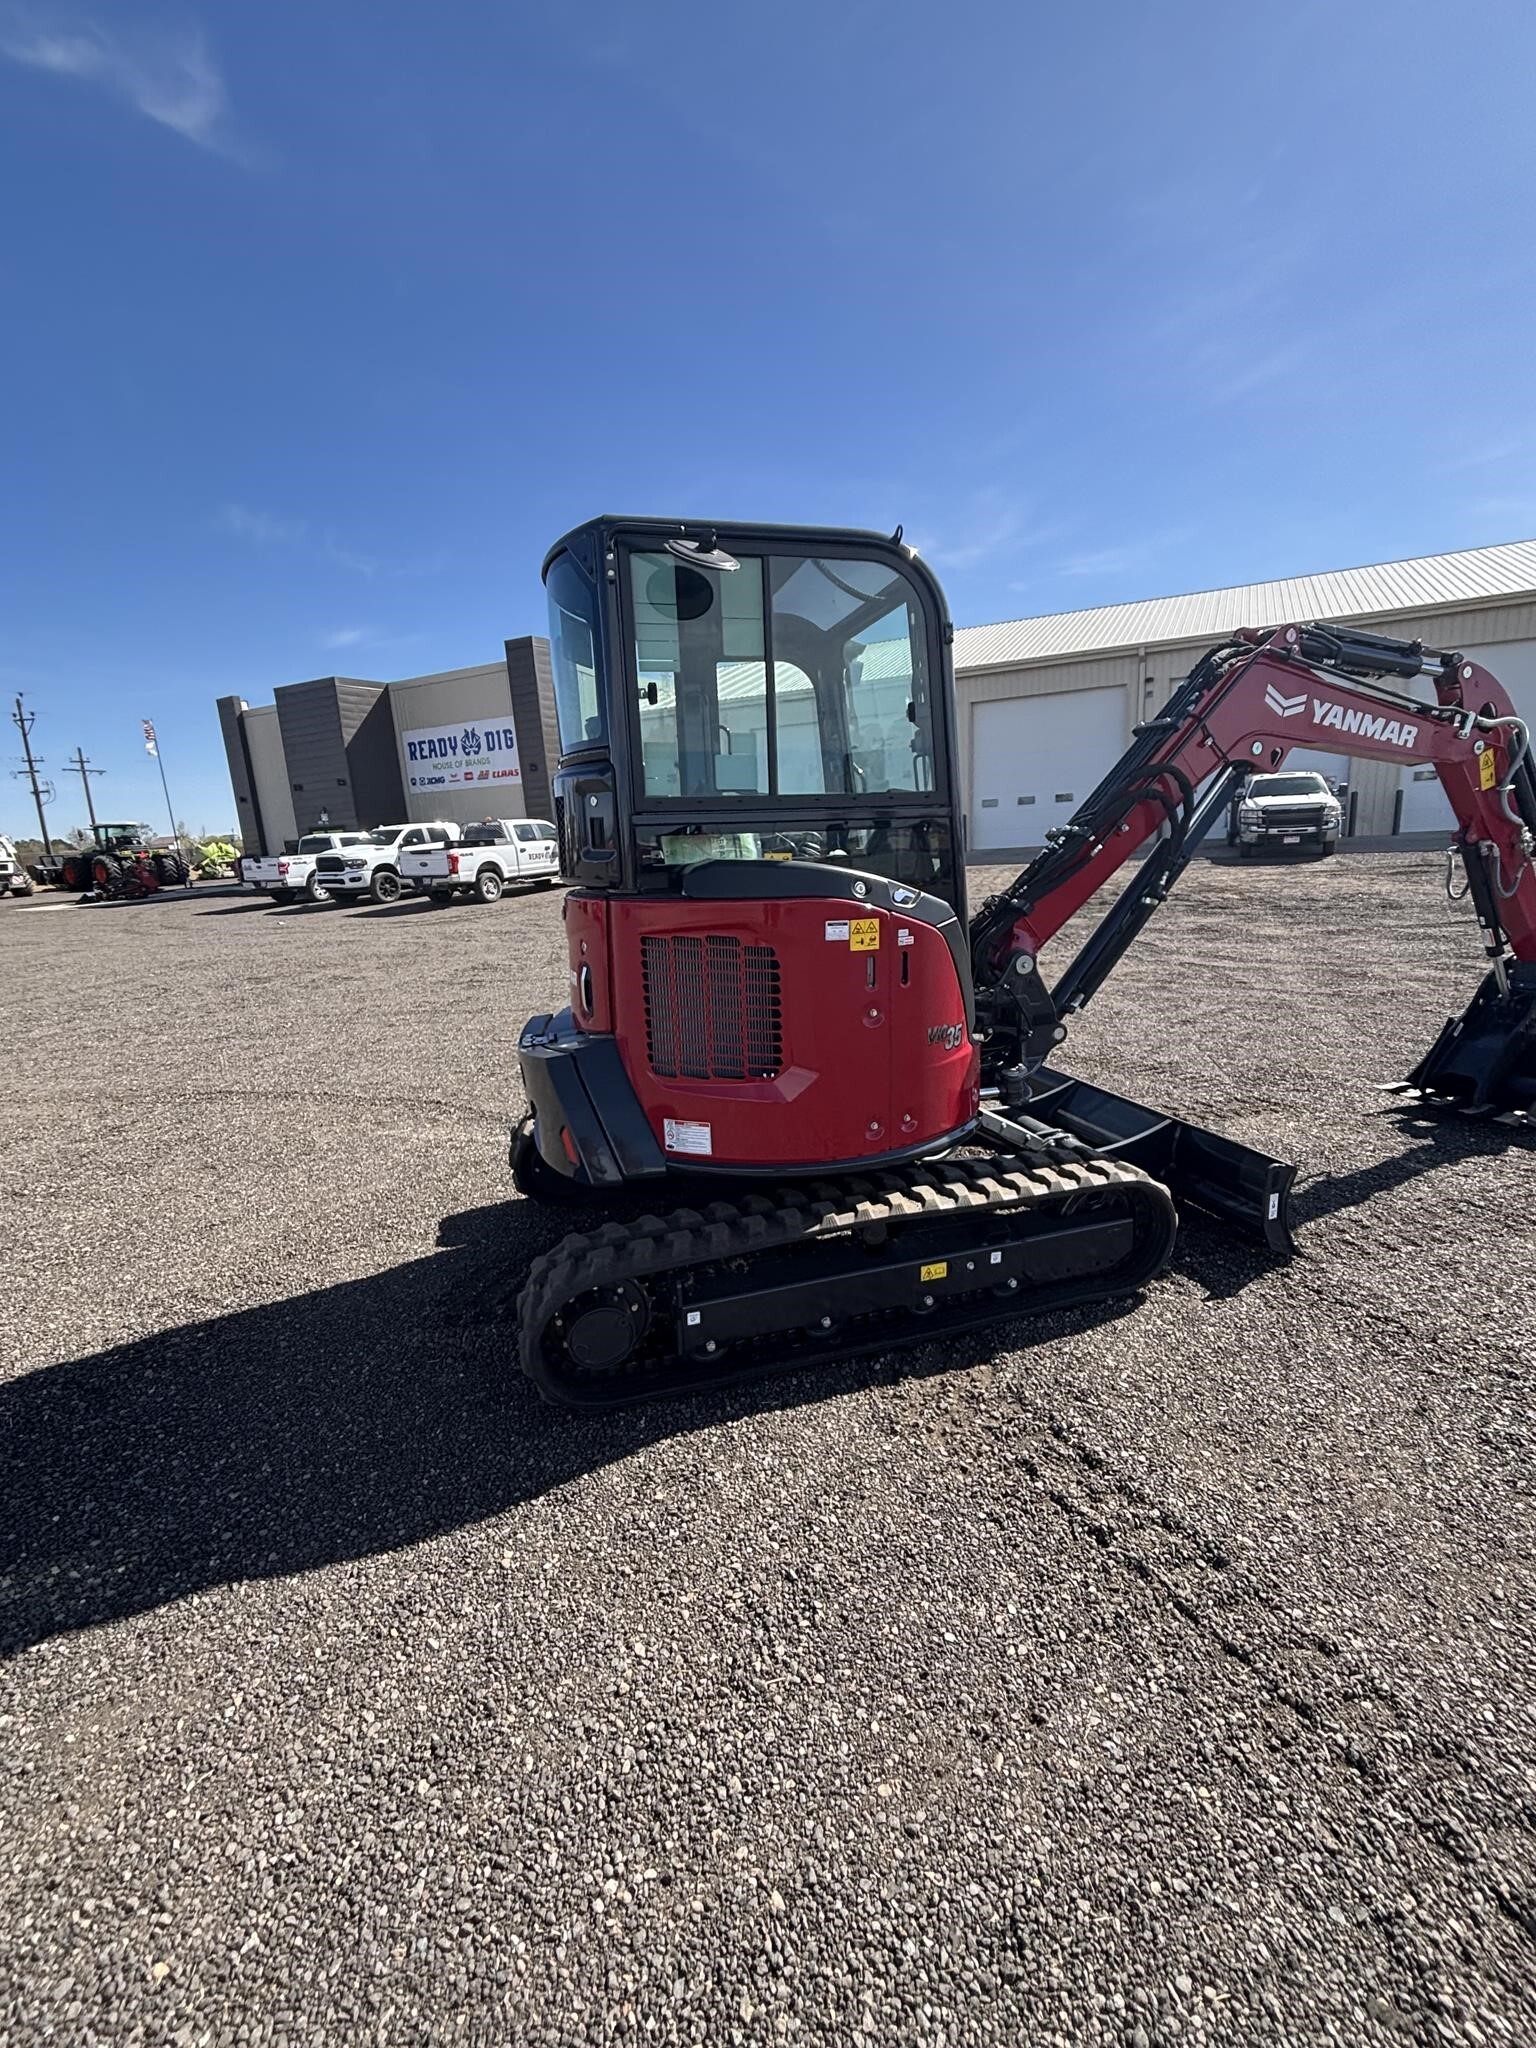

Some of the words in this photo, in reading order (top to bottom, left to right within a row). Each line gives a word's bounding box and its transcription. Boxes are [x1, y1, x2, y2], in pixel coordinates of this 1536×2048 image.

[1312, 698, 1418, 748] YANMAR
[407, 735, 458, 760] READY
[484, 729, 514, 751] DIG
[432, 762, 453, 770] HOUSE
[454, 760, 463, 769] OF
[465, 757, 491, 767] BRANDS
[492, 768, 519, 778] CLAAS
